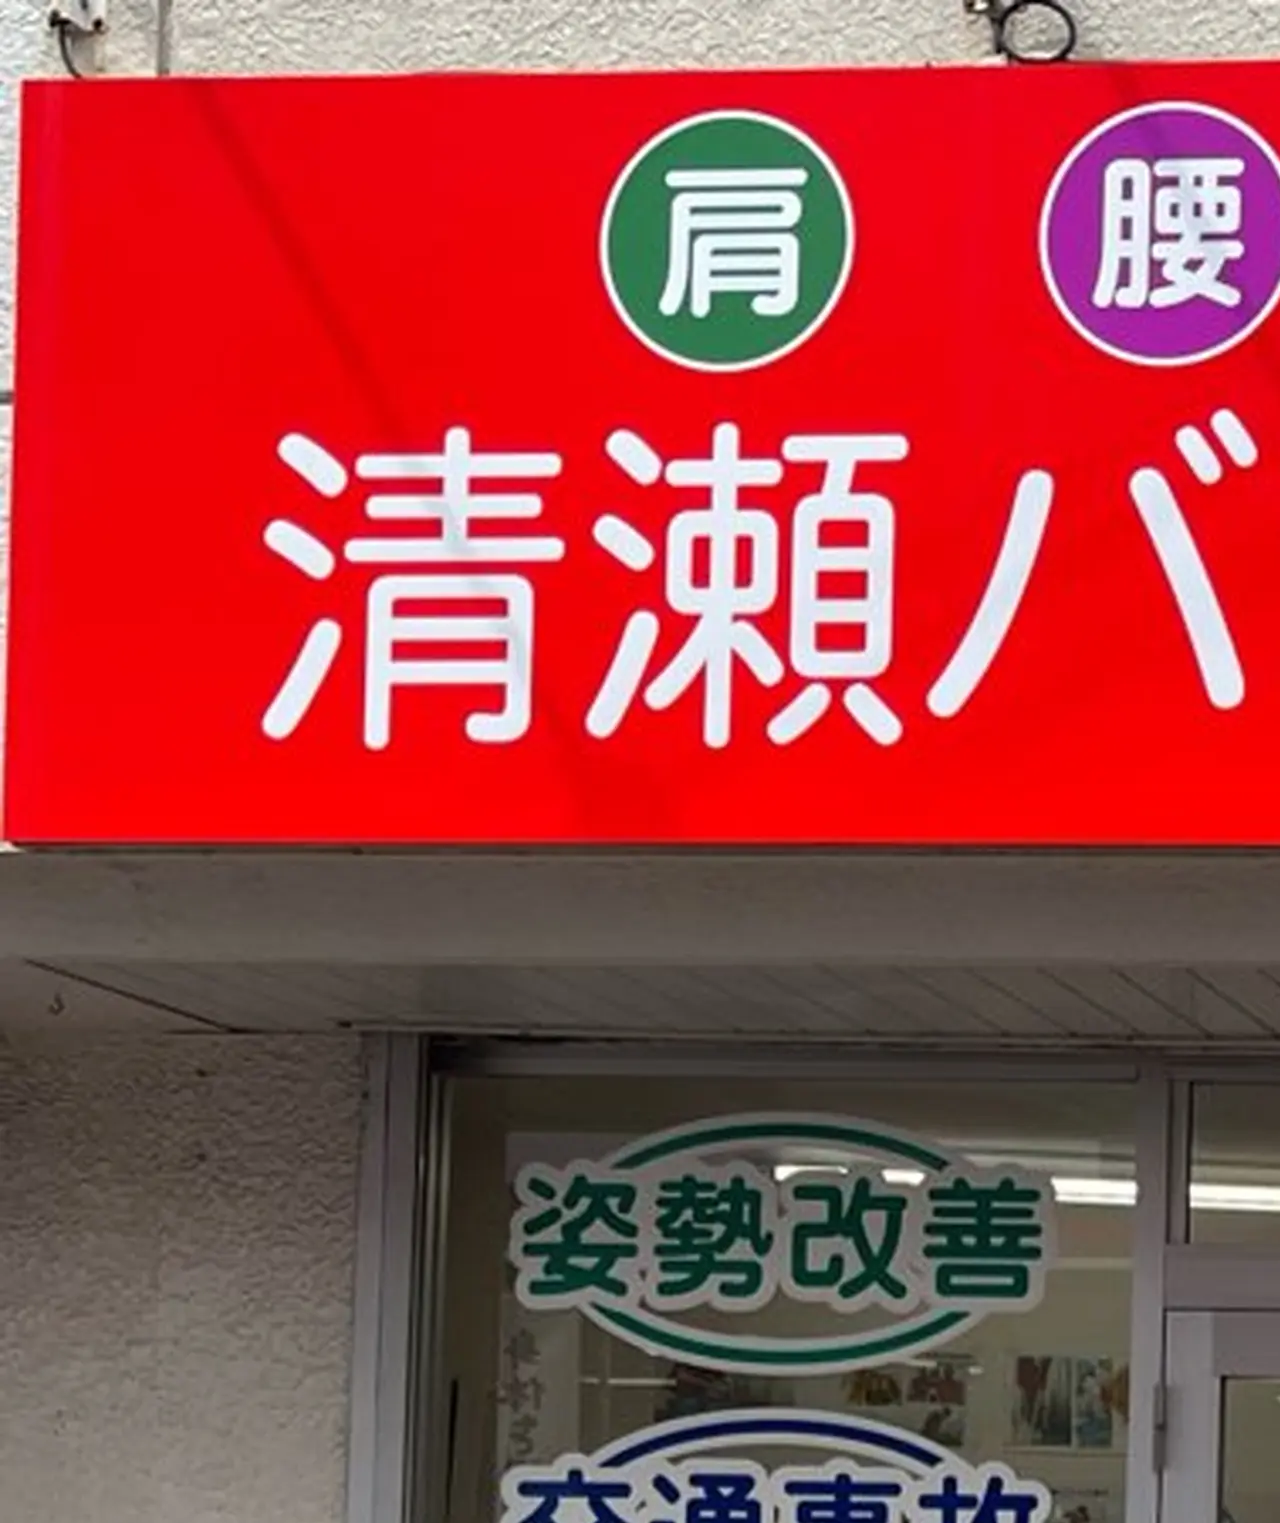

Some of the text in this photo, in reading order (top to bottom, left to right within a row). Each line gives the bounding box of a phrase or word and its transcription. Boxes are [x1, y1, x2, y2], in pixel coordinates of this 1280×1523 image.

[657, 165, 808, 319] 肩
[1091, 156, 1246, 309] 腰
[516, 1168, 1048, 1306] 姿勢改善
